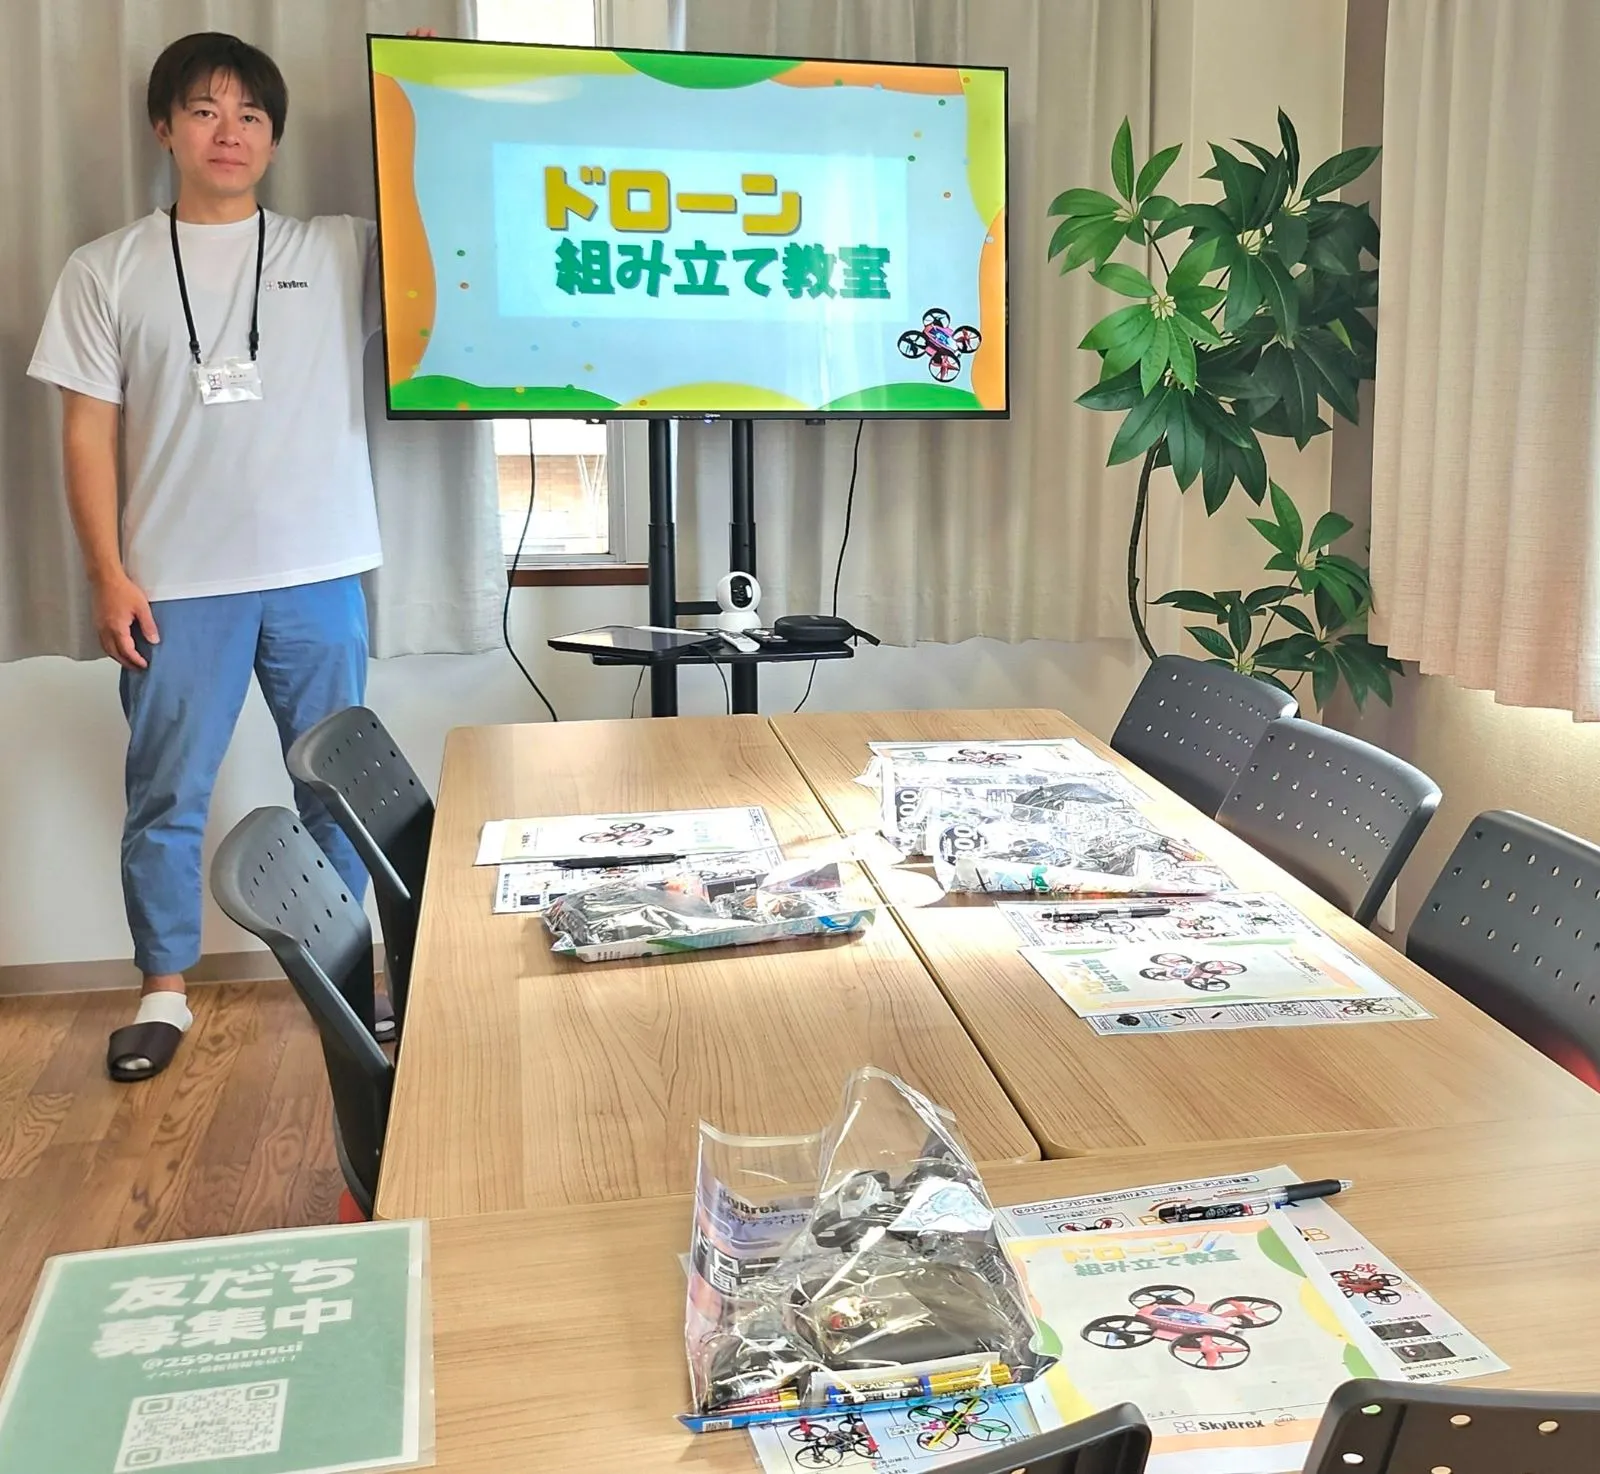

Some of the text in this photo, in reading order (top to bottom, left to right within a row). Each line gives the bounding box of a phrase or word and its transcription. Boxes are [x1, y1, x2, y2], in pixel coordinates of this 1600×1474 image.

[544, 166, 802, 235] ドローン
[555, 237, 890, 299] 組み立て教室
[1062, 1240, 1188, 1264] ドローン
[1073, 1249, 1241, 1277] 組み立て教室
[104, 1258, 358, 1314] 友だち
[91, 1298, 354, 1358] 募集中
[1199, 1419, 1265, 1431] SkyBrex
